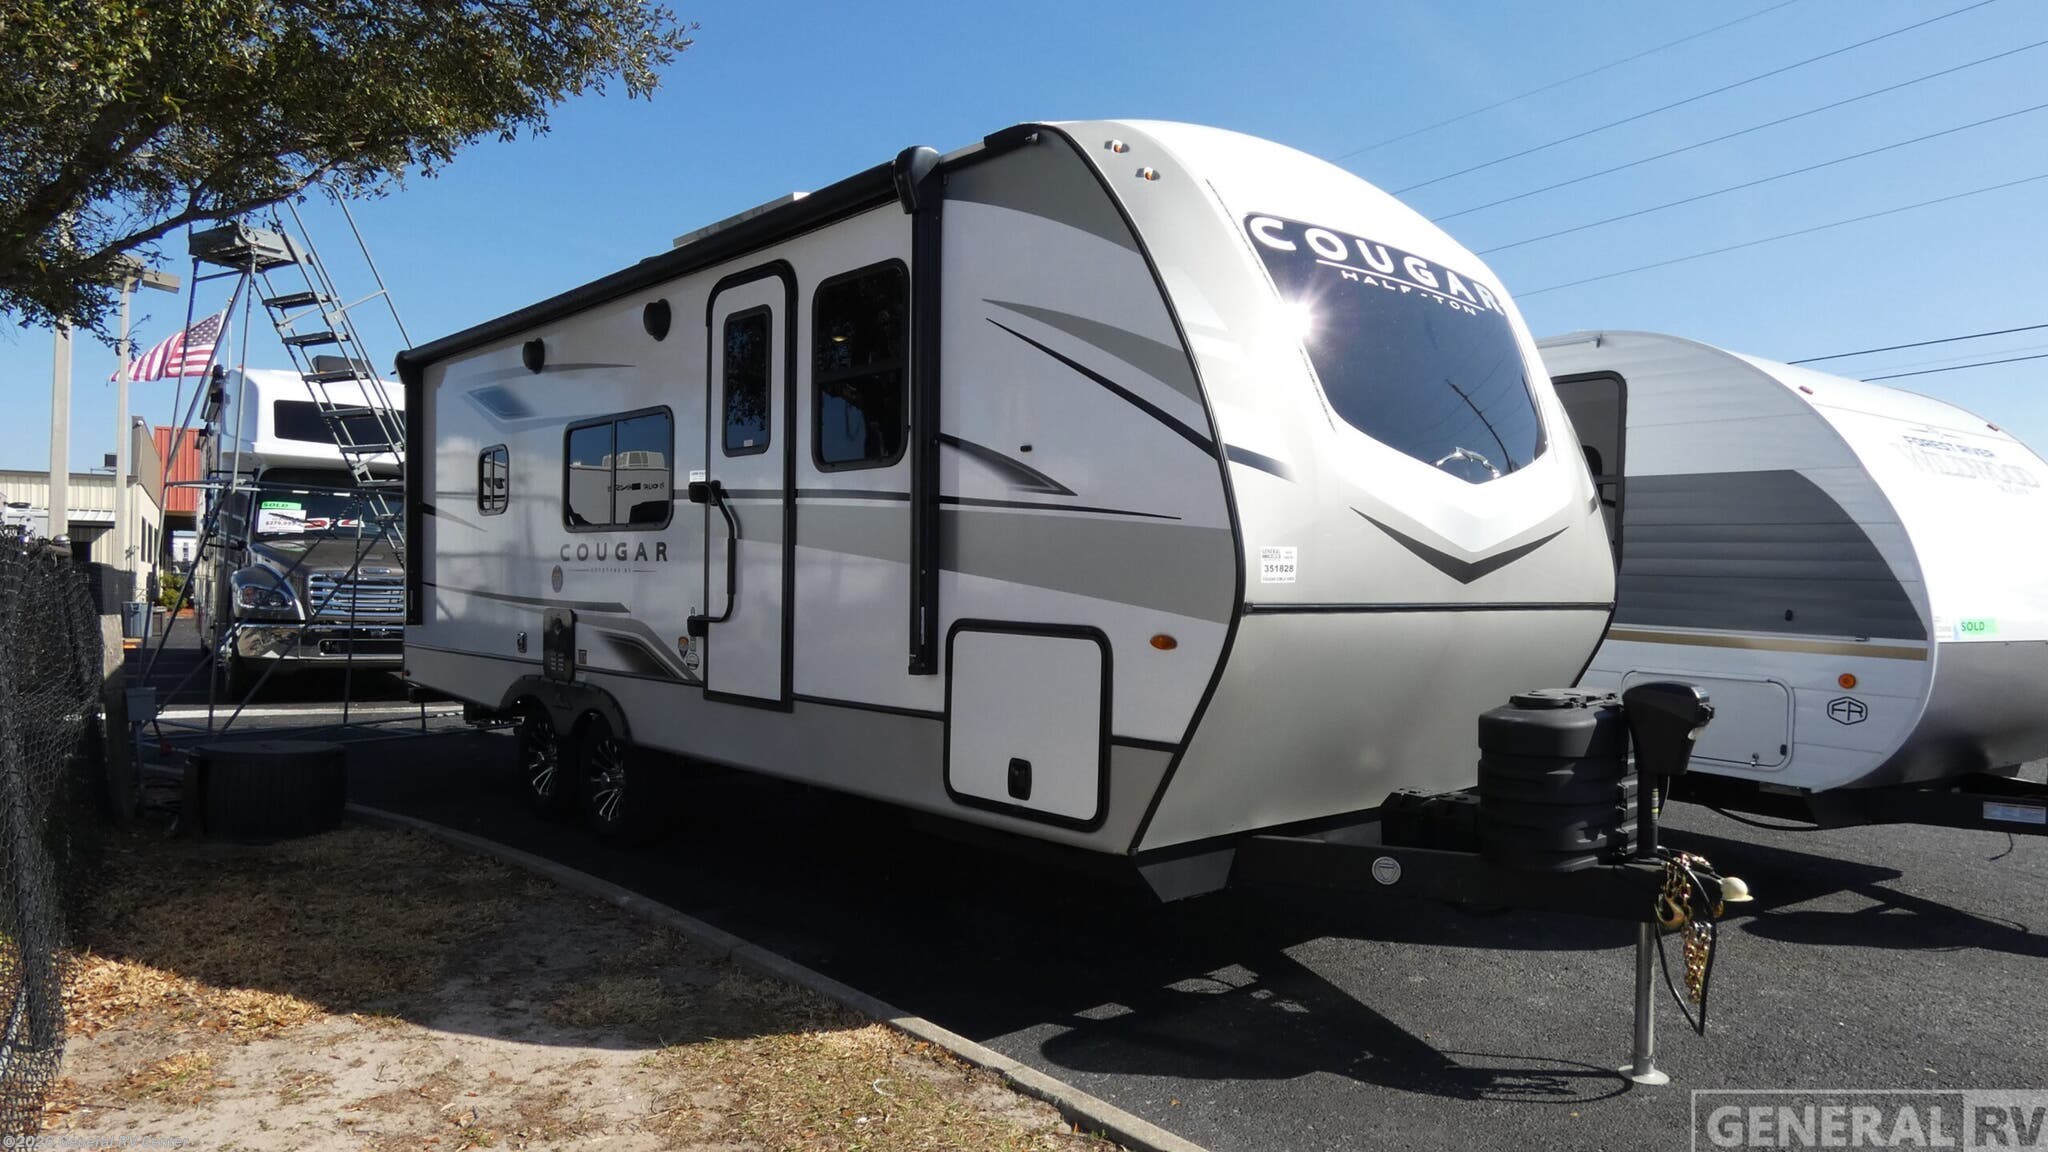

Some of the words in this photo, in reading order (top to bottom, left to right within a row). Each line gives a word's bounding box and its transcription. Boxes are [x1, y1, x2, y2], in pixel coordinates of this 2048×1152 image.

[1250, 216, 1505, 315] COUGAR
[1341, 270, 1477, 316] HALF-TON
[560, 541, 668, 562] COUGAR
[1264, 564, 1294, 573] 351828
[1961, 621, 1985, 632] SOLD
